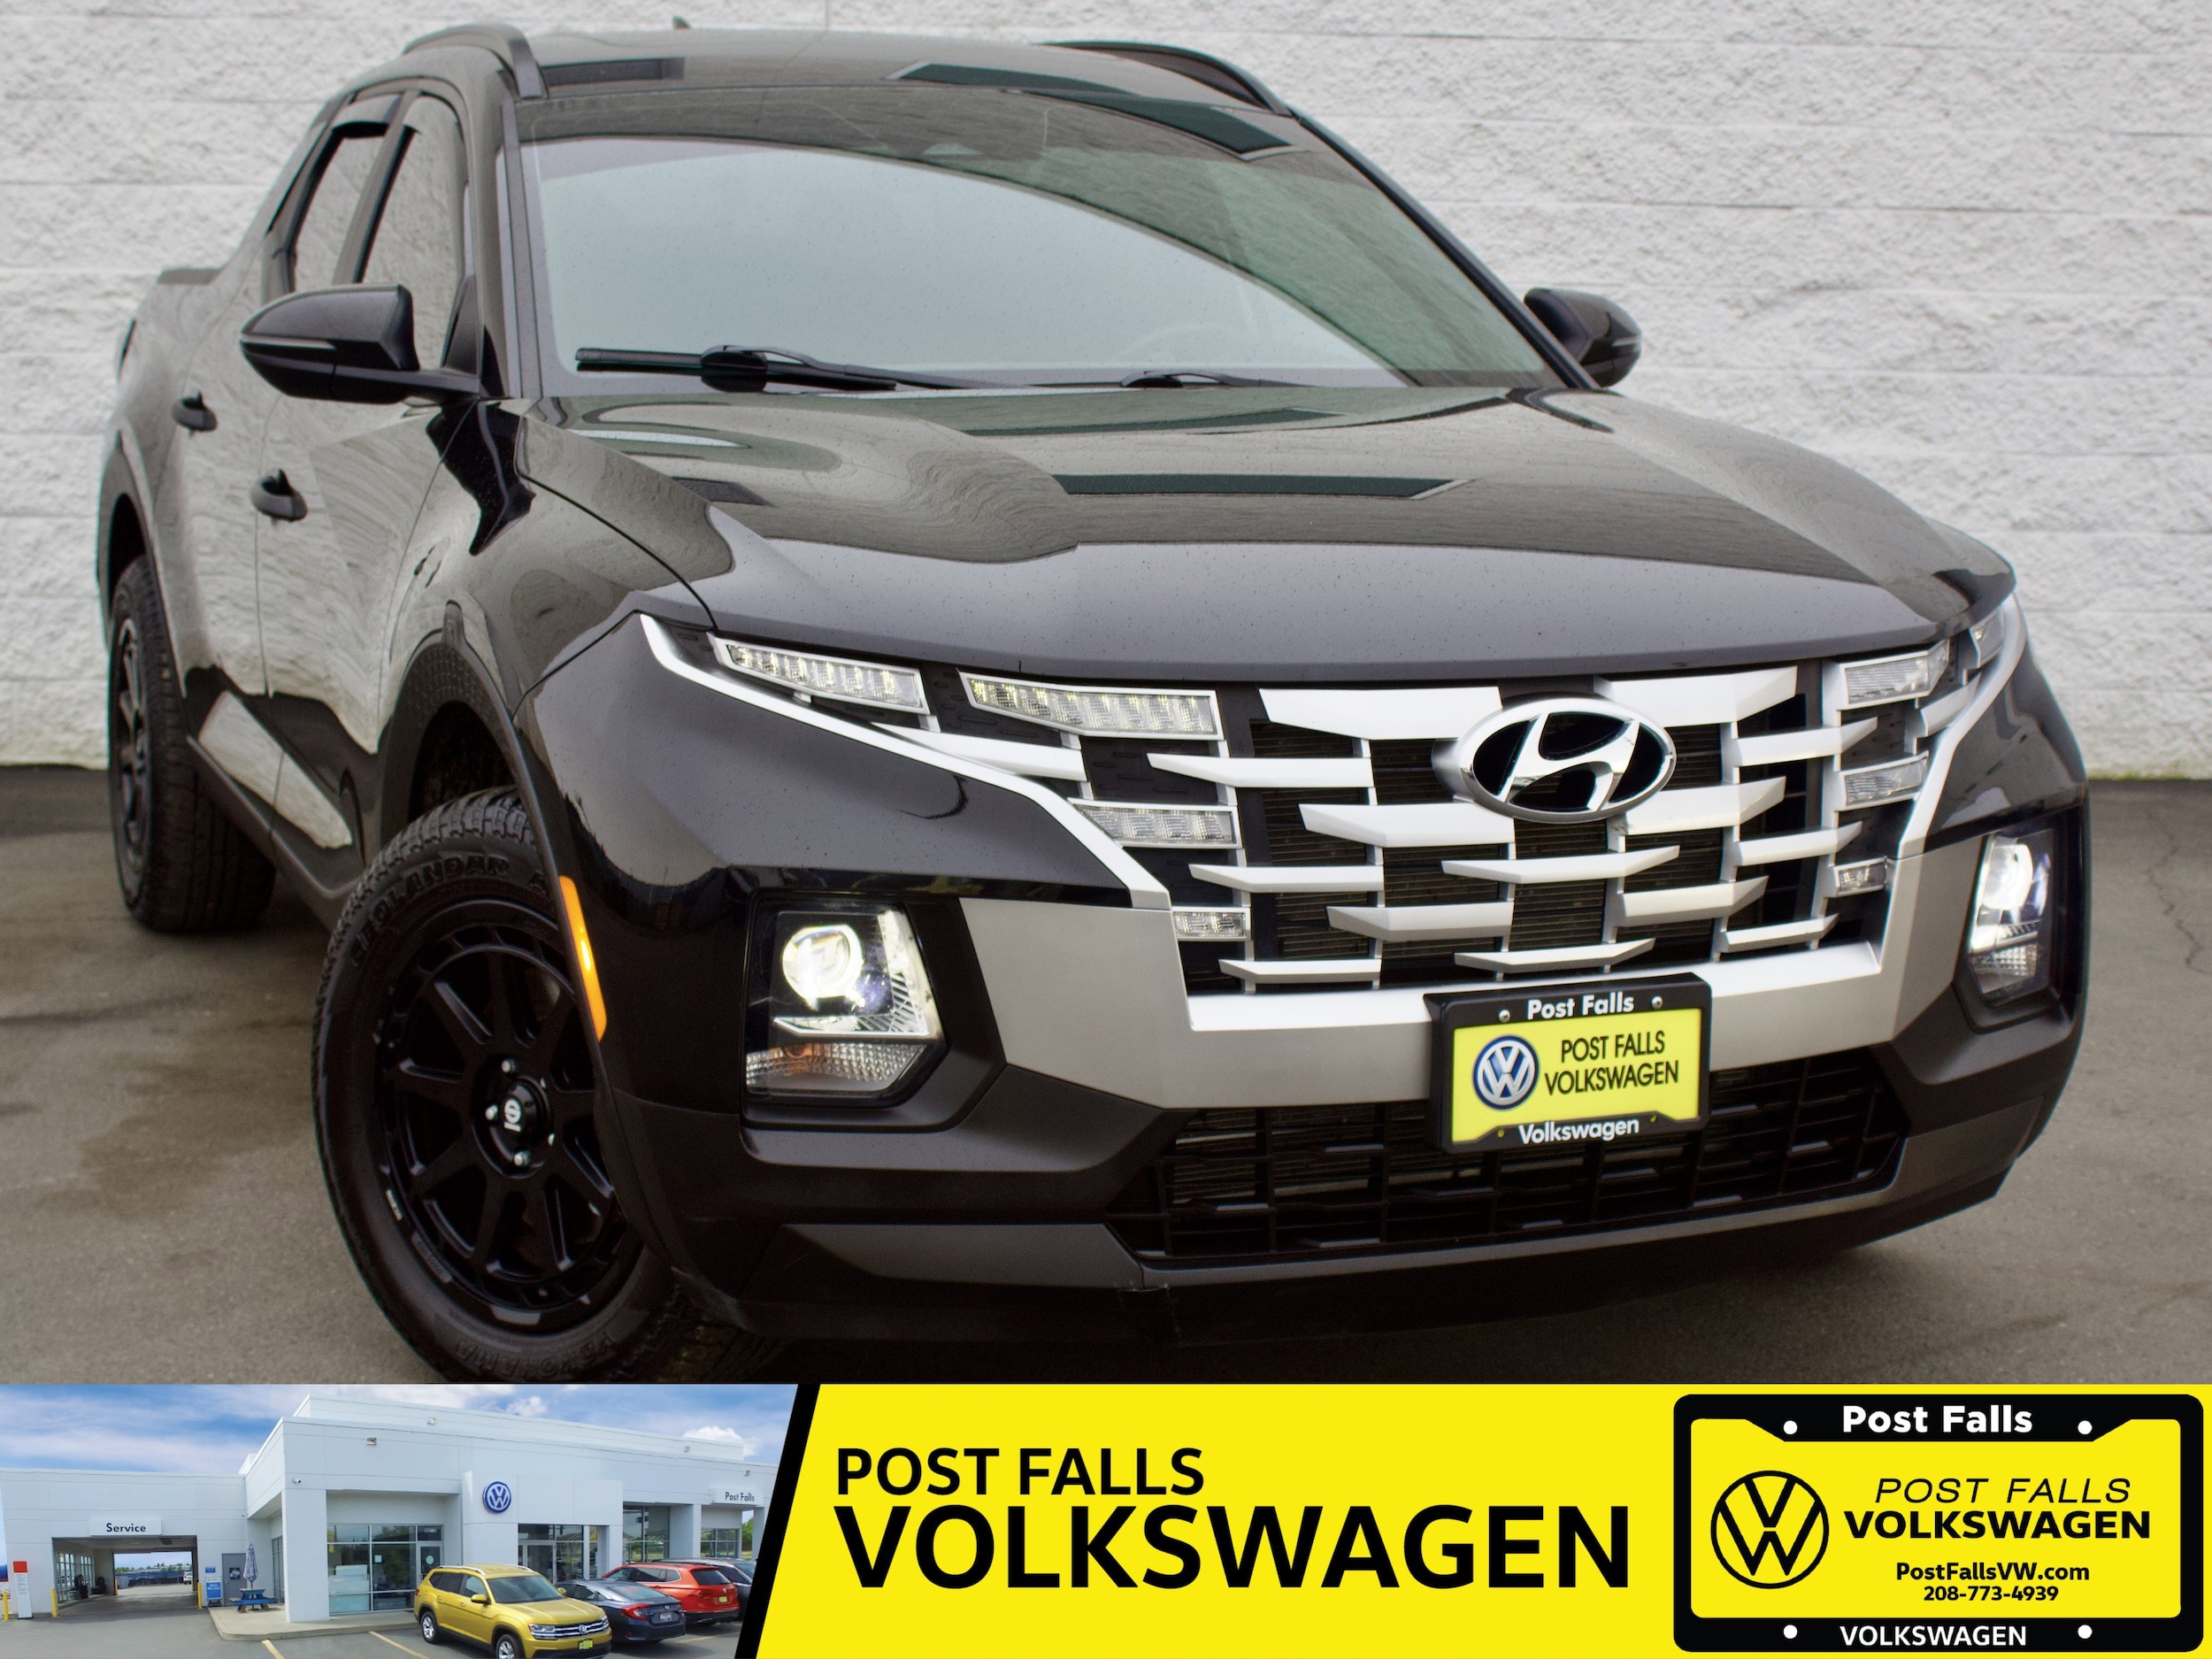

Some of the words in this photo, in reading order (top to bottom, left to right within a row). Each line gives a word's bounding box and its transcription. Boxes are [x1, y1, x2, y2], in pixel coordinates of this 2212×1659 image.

[1527, 998, 1575, 1020] Post
[1582, 991, 1635, 1016] Falls
[1561, 1036, 1609, 1064] POST
[1614, 1030, 1665, 1058] FALLS
[1545, 1060, 1679, 1096] VOLKSWAGEN
[1518, 1119, 1640, 1145] Volkswagen
[725, 1491, 739, 1501] Post
[740, 1492, 755, 1502] Falls
[105, 1522, 147, 1532] Service
